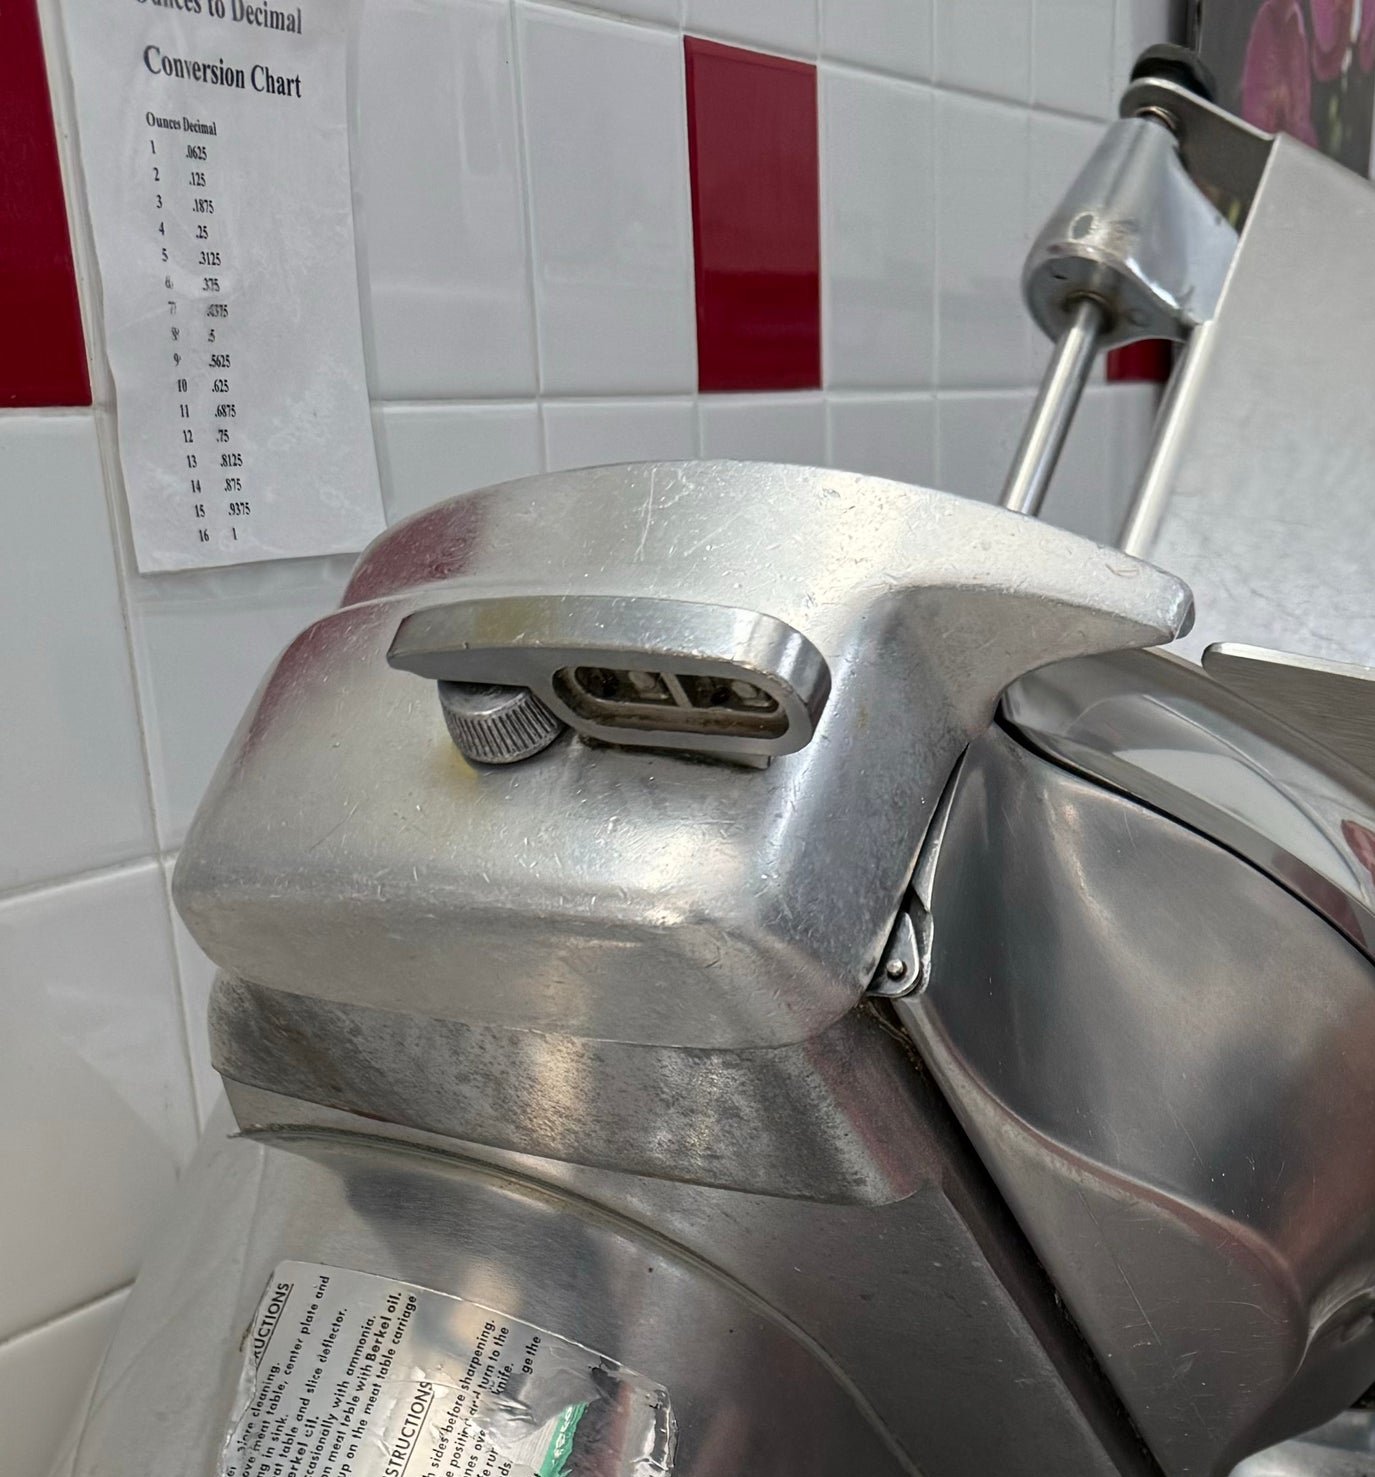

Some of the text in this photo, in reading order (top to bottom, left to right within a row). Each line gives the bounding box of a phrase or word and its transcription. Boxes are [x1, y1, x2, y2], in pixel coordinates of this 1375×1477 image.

[232, 0, 301, 34] Decimal
[144, 46, 301, 98] Conversion Chart
[146, 112, 216, 135] Ounces Decimal
[151, 140, 207, 160] 1 .0625
[153, 167, 205, 186] 2 .125
[157, 195, 214, 213] 3 .1875
[159, 222, 208, 239] 4 .25
[162, 248, 221, 265] 5 .3125
[165, 277, 219, 291] 6 .375
[168, 301, 176, 314] 7
[171, 327, 215, 342] 8 .5
[173, 353, 230, 367] 9 .5625
[178, 379, 229, 392] 10 .625
[180, 404, 236, 417] 11 .6875
[183, 429, 229, 442] 12 .75
[187, 453, 242, 468] 13 .8125
[191, 478, 241, 492] 14 .875
[195, 502, 250, 517] 15 .9375
[199, 528, 237, 541] 16 1
[390, 1294, 417, 1345] carriage
[492, 1326, 509, 1347] the
[524, 1335, 541, 1356] the
[251, 1419, 270, 1451] meat
[264, 1379, 288, 1415] table,
[283, 1337, 303, 1375] center
[299, 1302, 319, 1335] plate
[313, 1274, 330, 1299] and
[330, 1379, 349, 1408] with
[344, 1314, 376, 1376] ammonia.
[374, 1347, 396, 1379] table
[487, 1347, 501, 1362] to
[277, 1424, 299, 1458] table
[294, 1396, 310, 1422] and
[304, 1366, 323, 1393] slice
[316, 1307, 347, 1363] deflector.
[326, 1429, 346, 1462] meat
[339, 1394, 360, 1427] table
[354, 1363, 373, 1392] with
[364, 1315, 392, 1362] Berkel
[385, 1291, 401, 1313] oil.
[440, 1393, 466, 1433] before
[458, 1319, 496, 1391] sharpening.
[476, 1363, 495, 1389] turn
[490, 1361, 514, 1396] knife.
[252, 1361, 281, 1418] cleaning.
[362, 1382, 382, 1415] meat
[261, 1445, 275, 1458] in
[269, 1413, 288, 1442] sink.
[350, 1418, 368, 1439] the
[345, 1443, 358, 1459] on
